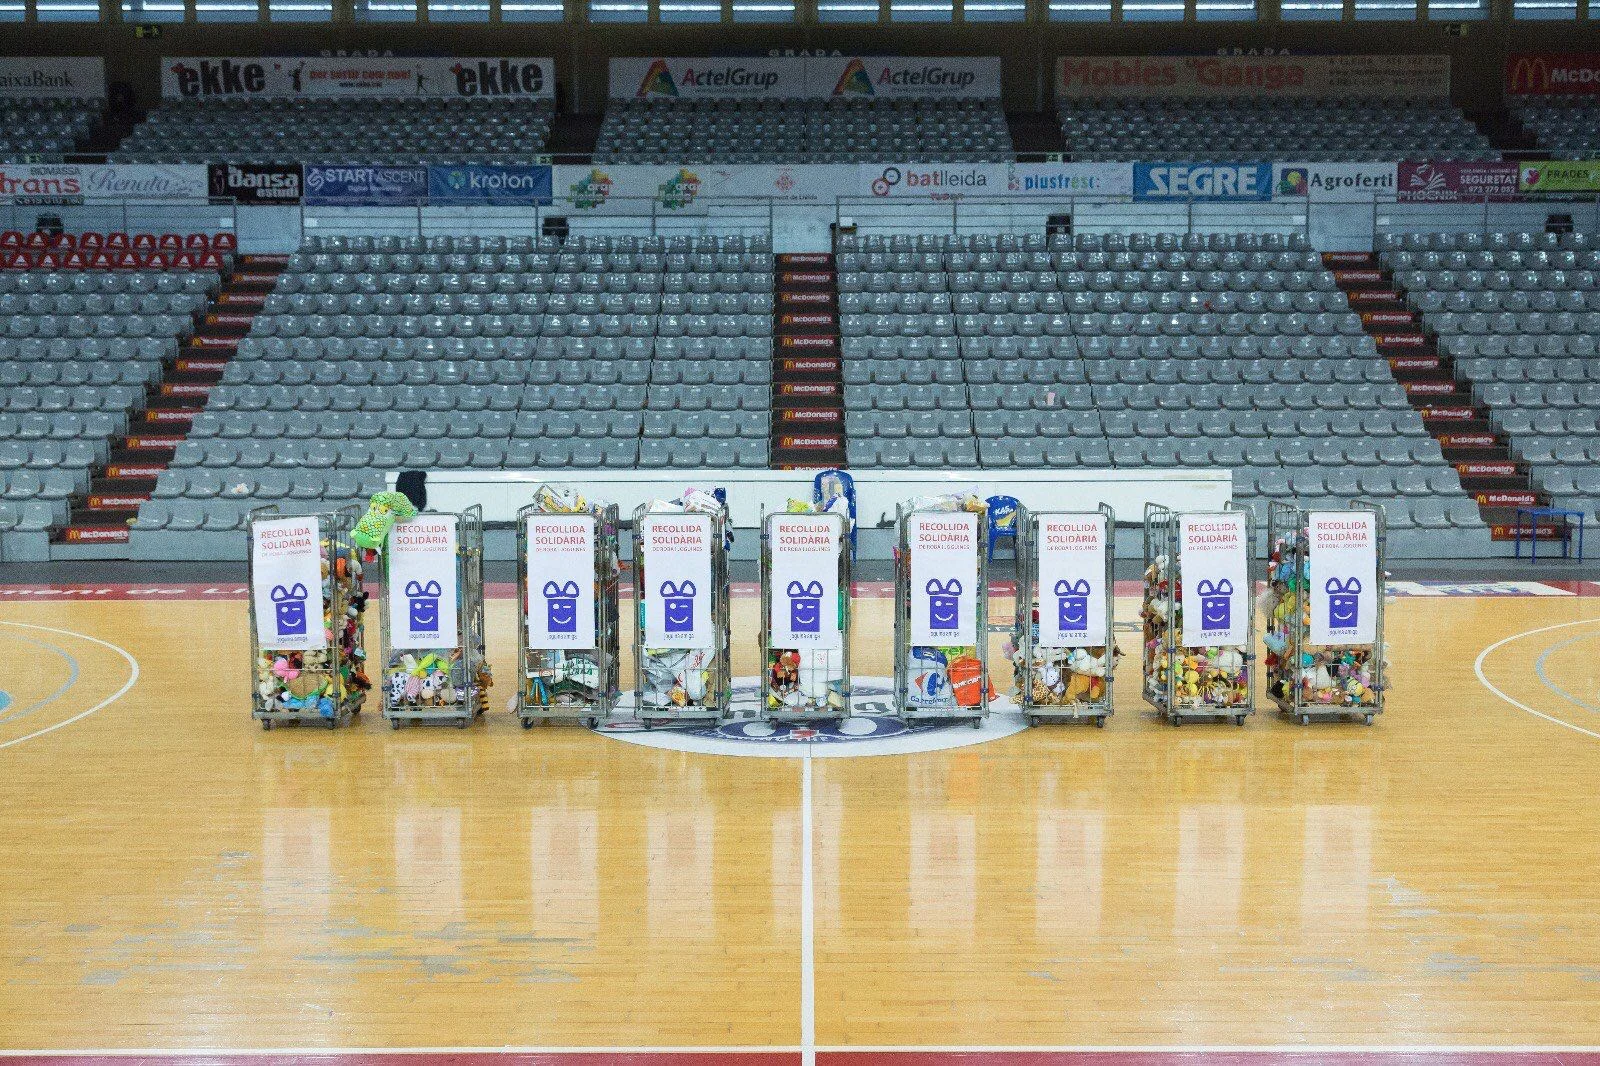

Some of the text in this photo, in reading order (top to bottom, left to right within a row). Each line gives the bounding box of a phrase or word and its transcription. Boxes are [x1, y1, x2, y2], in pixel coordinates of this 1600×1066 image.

[177, 60, 266, 97] ekke
[456, 60, 545, 96] ekke
[681, 68, 779, 90] ActelGrup
[877, 67, 976, 90] ActelGrup
[469, 171, 534, 189] kroton
[906, 170, 987, 187] batlleida
[1146, 166, 1258, 196] SEGRE
[1310, 172, 1394, 191] Agroferti
[396, 525, 448, 533] RECOLLIDA
[535, 525, 586, 533] RECOLLIDA
[652, 525, 702, 533] RECOLLIDA
[779, 525, 830, 533] RECOLLIDA
[919, 522, 970, 531] RECOLLIDA
[1047, 524, 1098, 532] RECOLLIDA
[1188, 523, 1238, 532] RECOLLIDA
[1317, 521, 1367, 530] RECOLLIDA
[261, 527, 311, 539] RECOLLIDA
